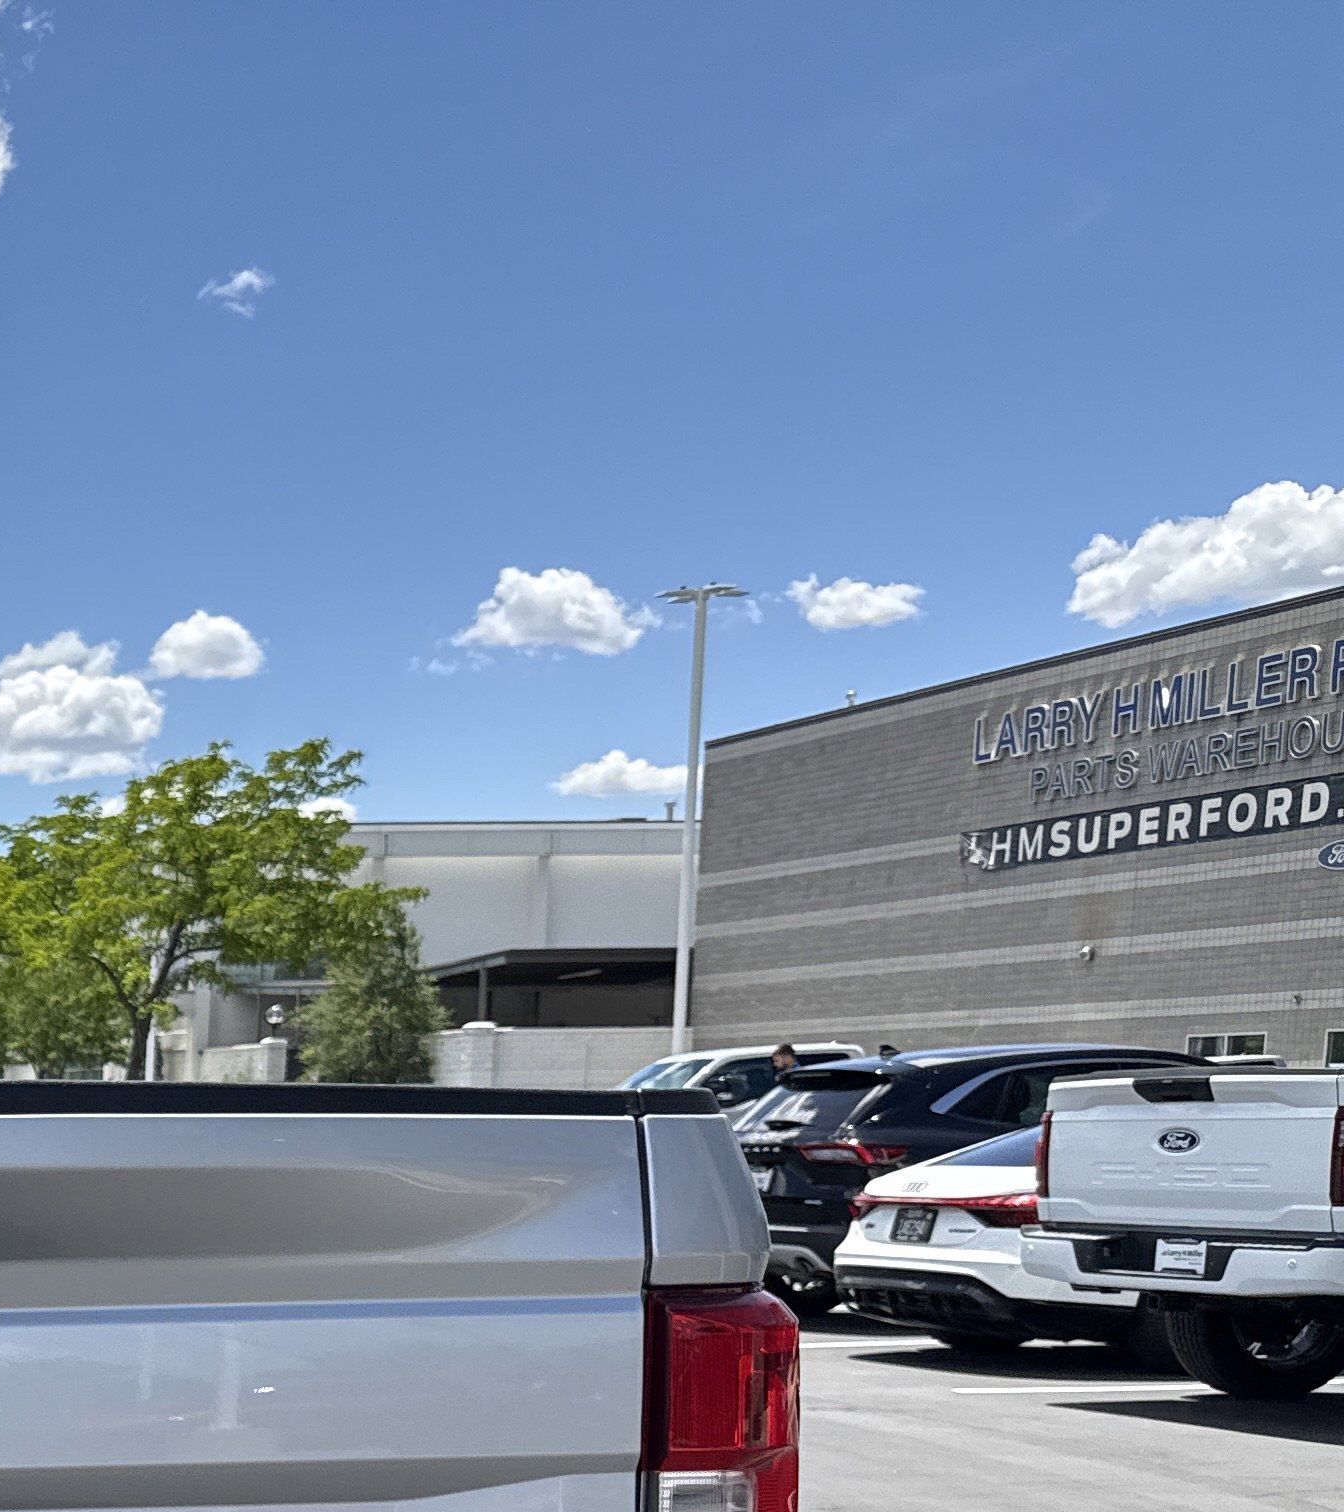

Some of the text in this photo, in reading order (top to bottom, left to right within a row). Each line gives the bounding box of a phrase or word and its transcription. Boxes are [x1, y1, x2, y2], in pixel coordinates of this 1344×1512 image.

[974, 690, 1103, 765] LARRY
[1111, 681, 1140, 738] H
[1148, 643, 1323, 730] MILLER
[1031, 747, 1140, 803] PARTS
[1163, 1131, 1192, 1149] Ford
